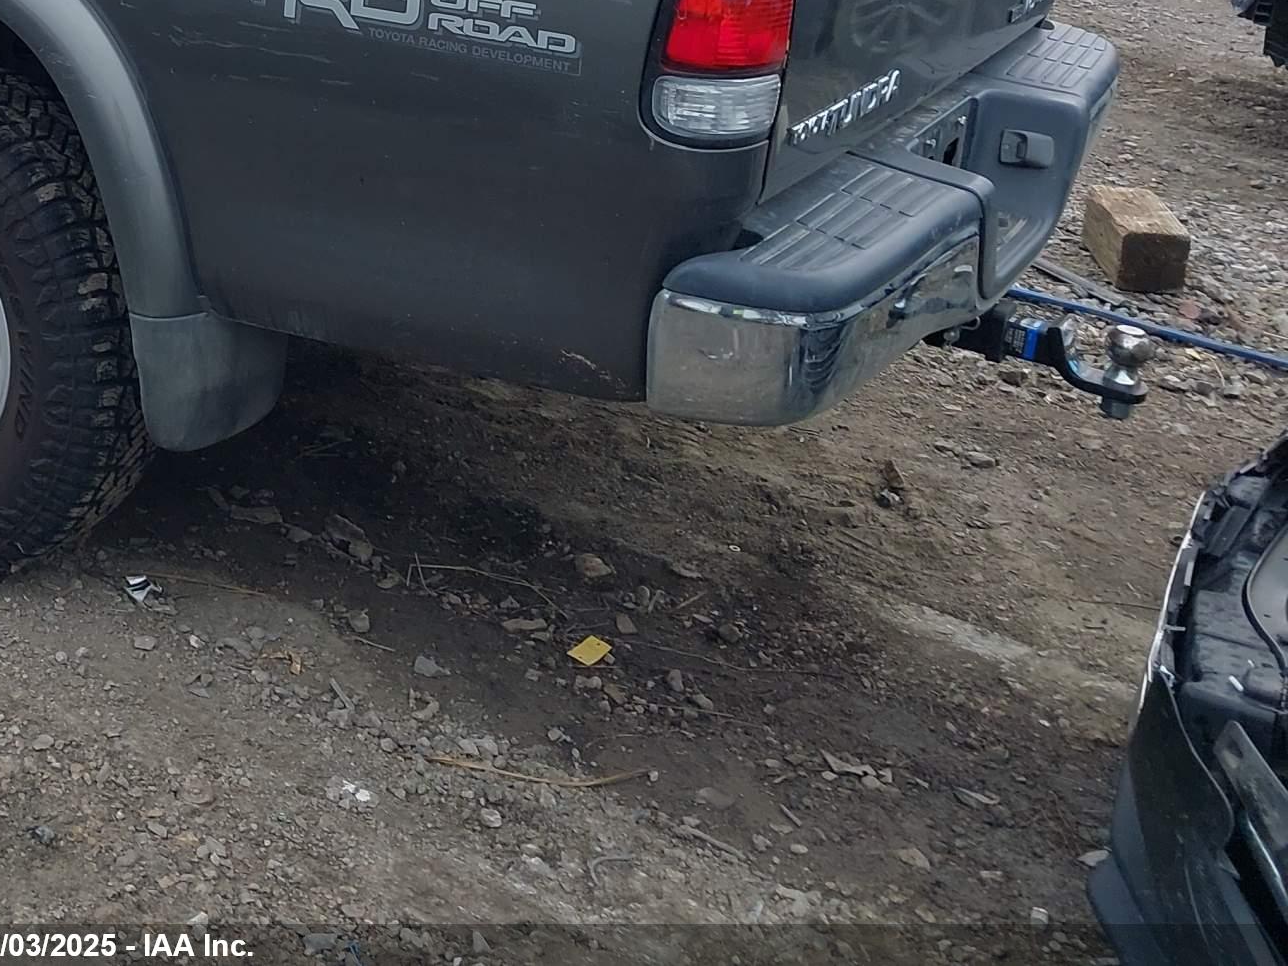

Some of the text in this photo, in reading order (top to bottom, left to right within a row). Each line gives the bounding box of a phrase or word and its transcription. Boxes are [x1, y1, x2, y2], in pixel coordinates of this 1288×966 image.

[367, 27, 571, 73] TOYOTA RACING DEVELOPMENT
[427, 12, 580, 57] ROAD
